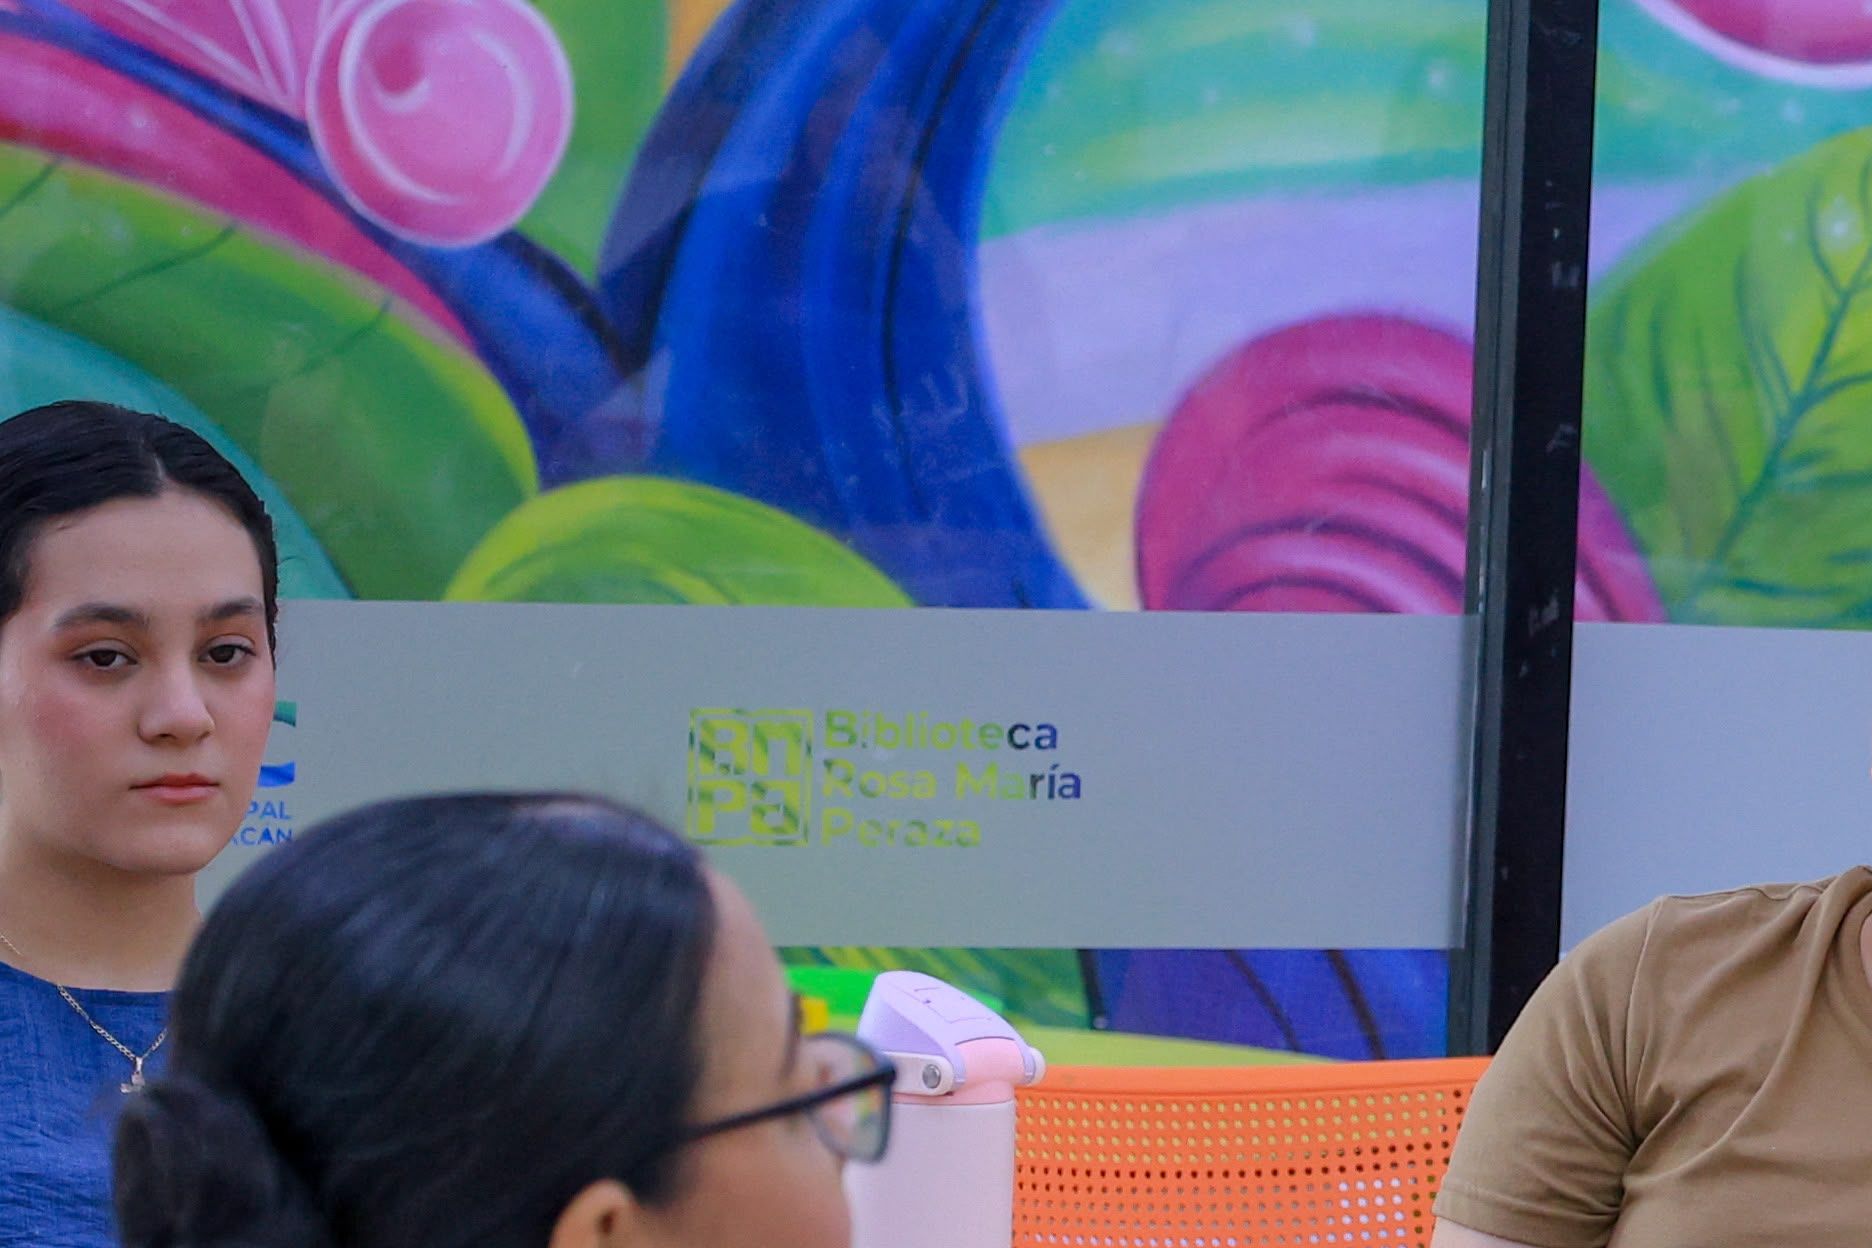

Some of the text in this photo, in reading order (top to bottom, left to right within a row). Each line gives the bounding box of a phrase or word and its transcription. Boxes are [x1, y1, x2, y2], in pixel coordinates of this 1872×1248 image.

[823, 710, 1058, 751] Biblioteca
[820, 759, 1082, 800] Rosa María
[819, 807, 982, 847] Peraza
